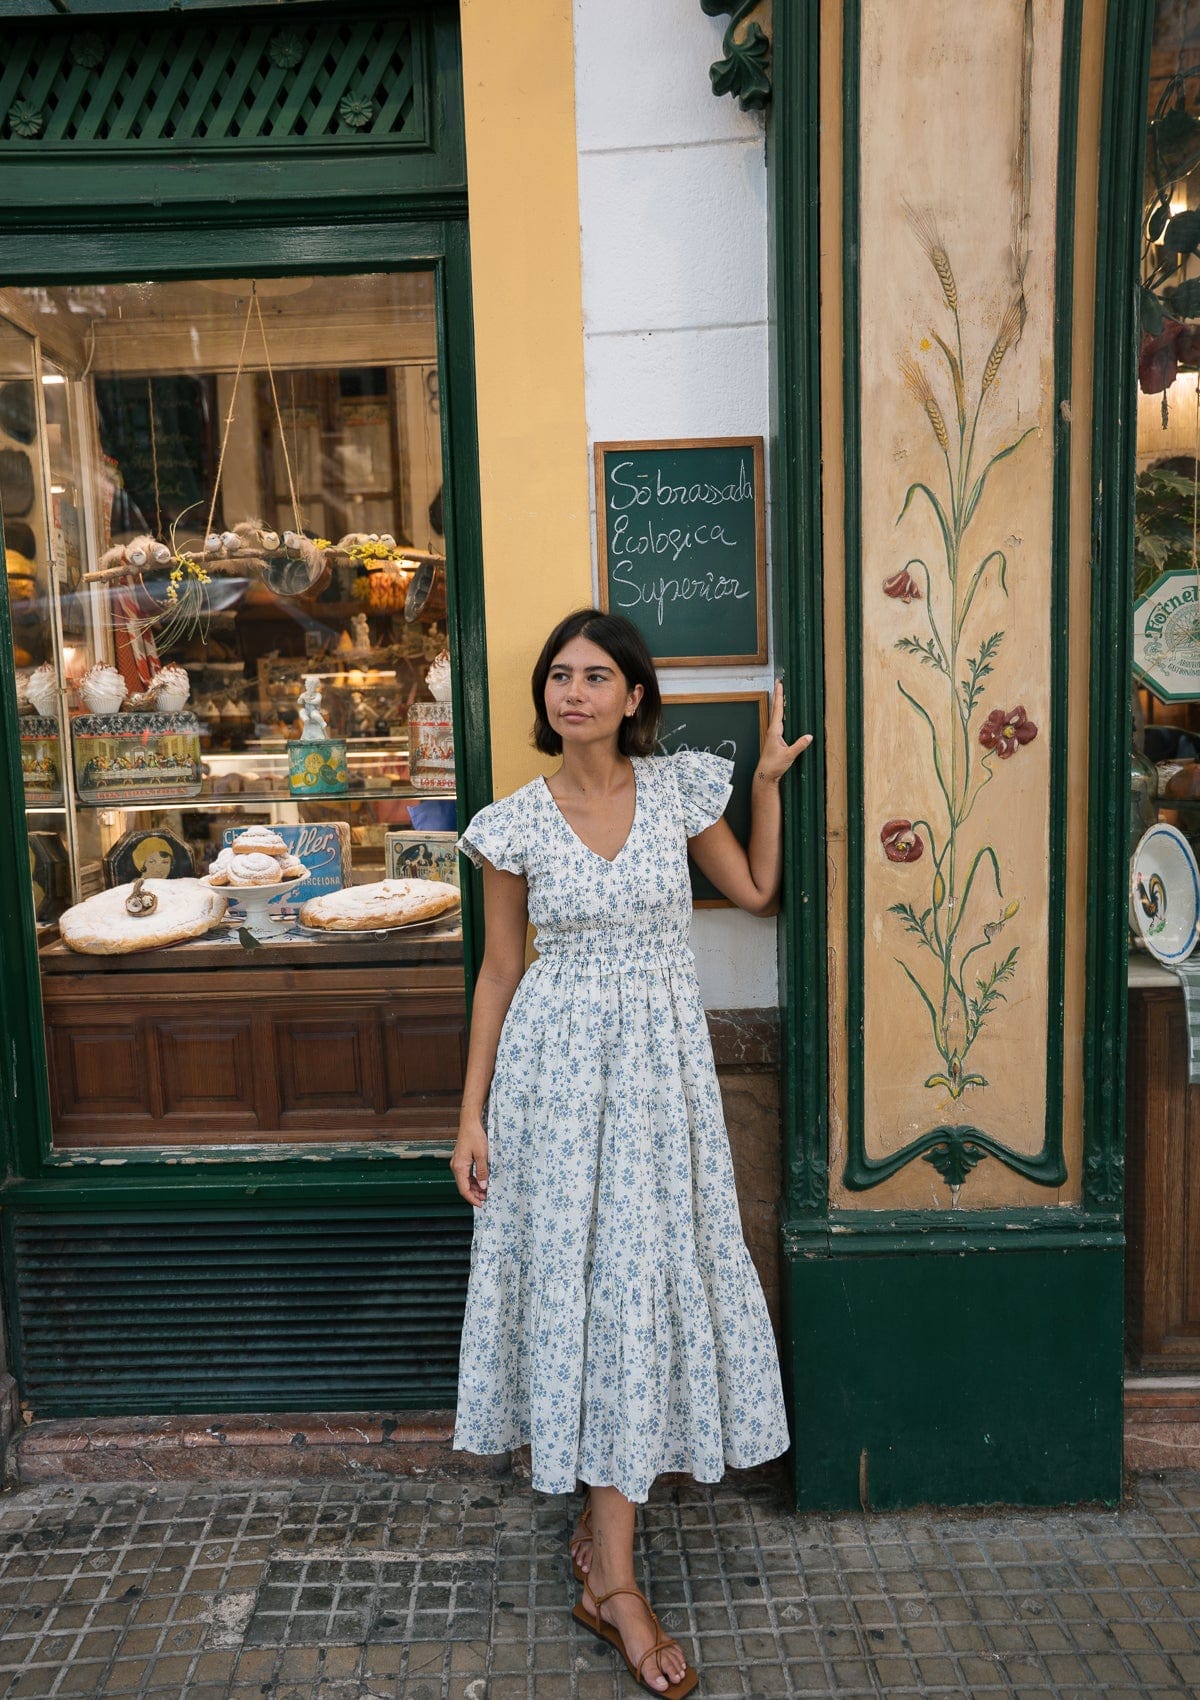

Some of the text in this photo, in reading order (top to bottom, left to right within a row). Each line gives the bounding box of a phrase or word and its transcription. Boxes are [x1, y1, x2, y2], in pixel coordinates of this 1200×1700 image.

[612, 515, 737, 560] Ecologica
[612, 560, 750, 626] Superior
[301, 877, 340, 886] ARCELONA
